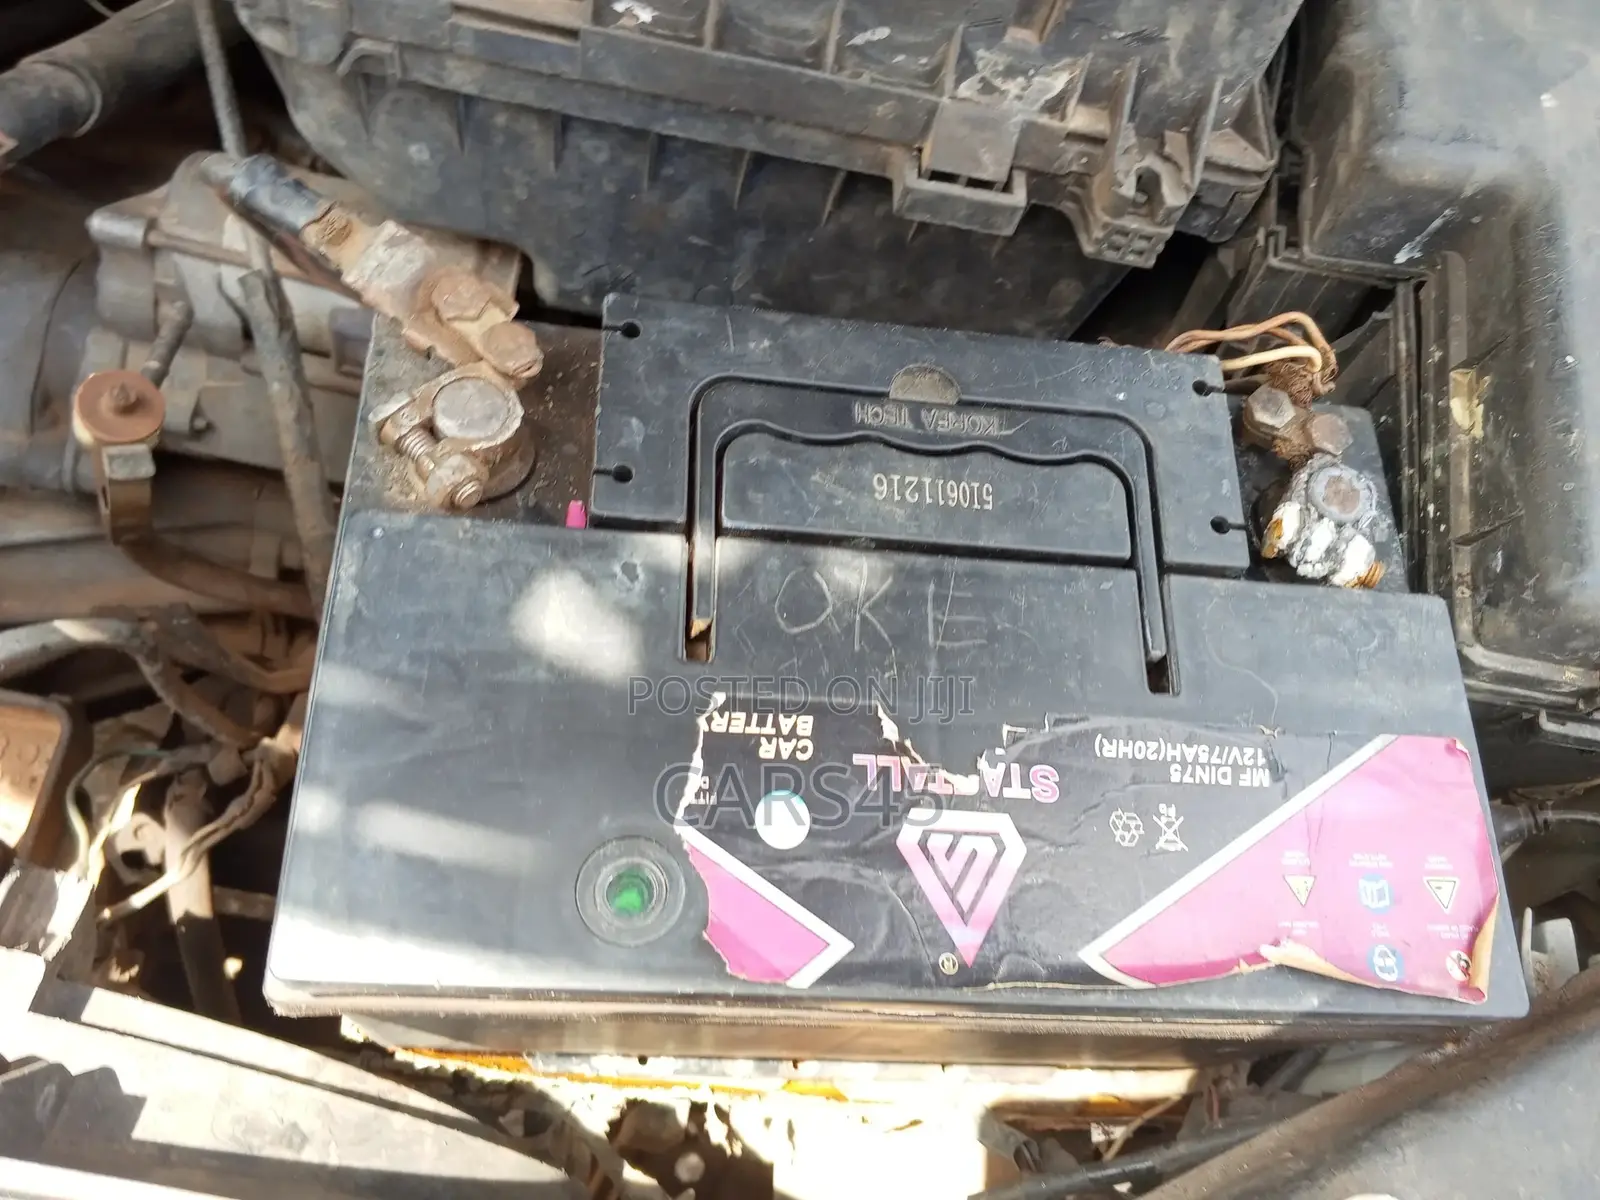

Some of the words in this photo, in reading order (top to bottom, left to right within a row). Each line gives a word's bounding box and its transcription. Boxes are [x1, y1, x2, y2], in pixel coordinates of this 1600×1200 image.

[758, 737, 814, 761] CAR
[1094, 734, 1266, 766] 12V/75AH(20HR)
[853, 753, 1060, 803] STATALL
[1170, 763, 1231, 785] DIN75
[1239, 768, 1270, 787] MF
